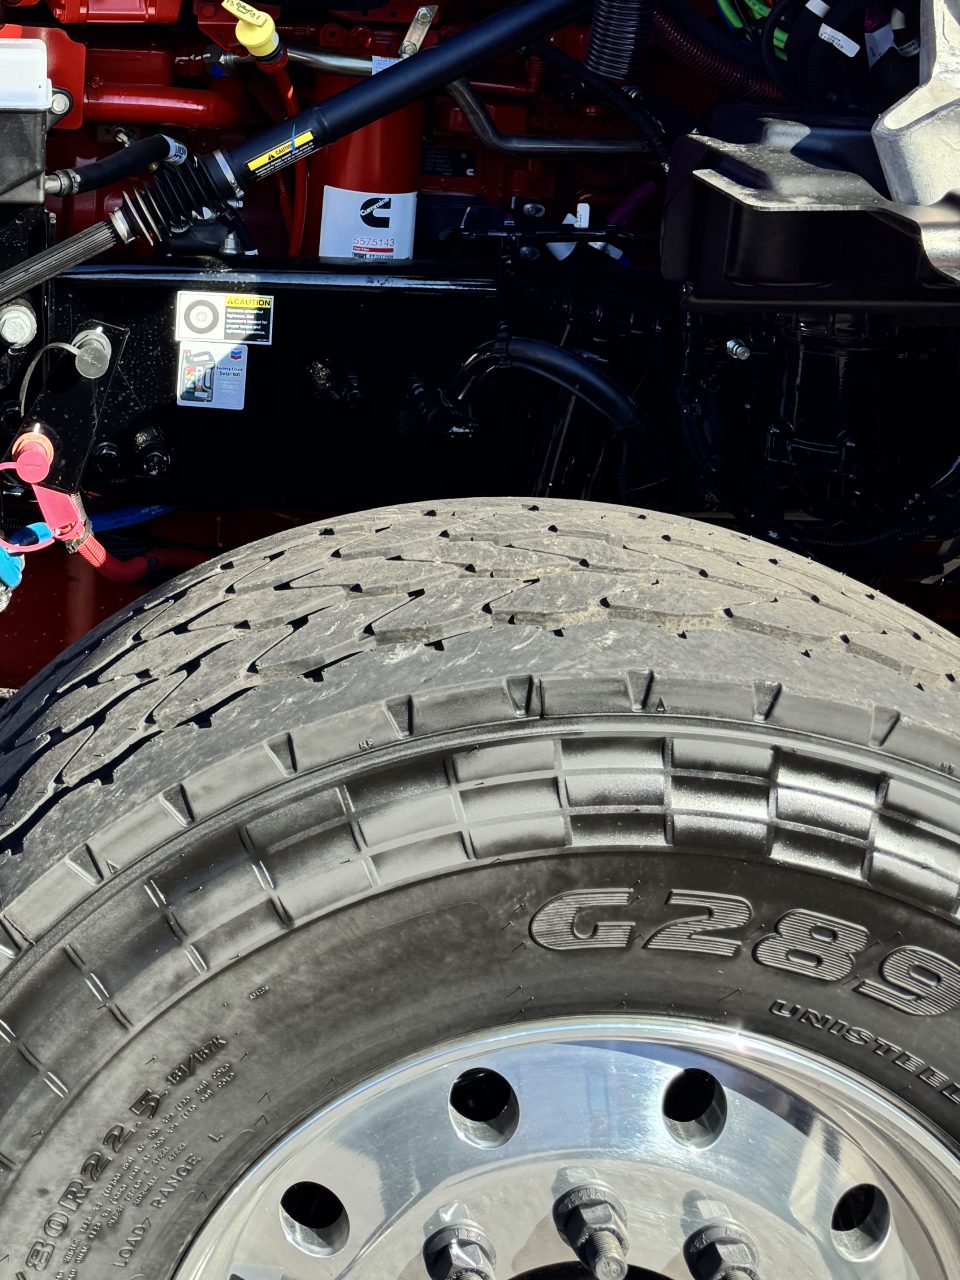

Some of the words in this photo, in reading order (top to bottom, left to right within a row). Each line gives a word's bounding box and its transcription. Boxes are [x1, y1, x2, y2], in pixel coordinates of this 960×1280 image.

[360, 197, 390, 217] Cummins
[353, 236, 395, 248] 5575143
[233, 297, 271, 307] CAUTION
[527, 887, 960, 1016] G289
[769, 999, 960, 1104] UNISTEEL
[111, 1222, 148, 1268] LOAD
[149, 1152, 203, 1210] RANGE
[206, 1132, 224, 1144] L
